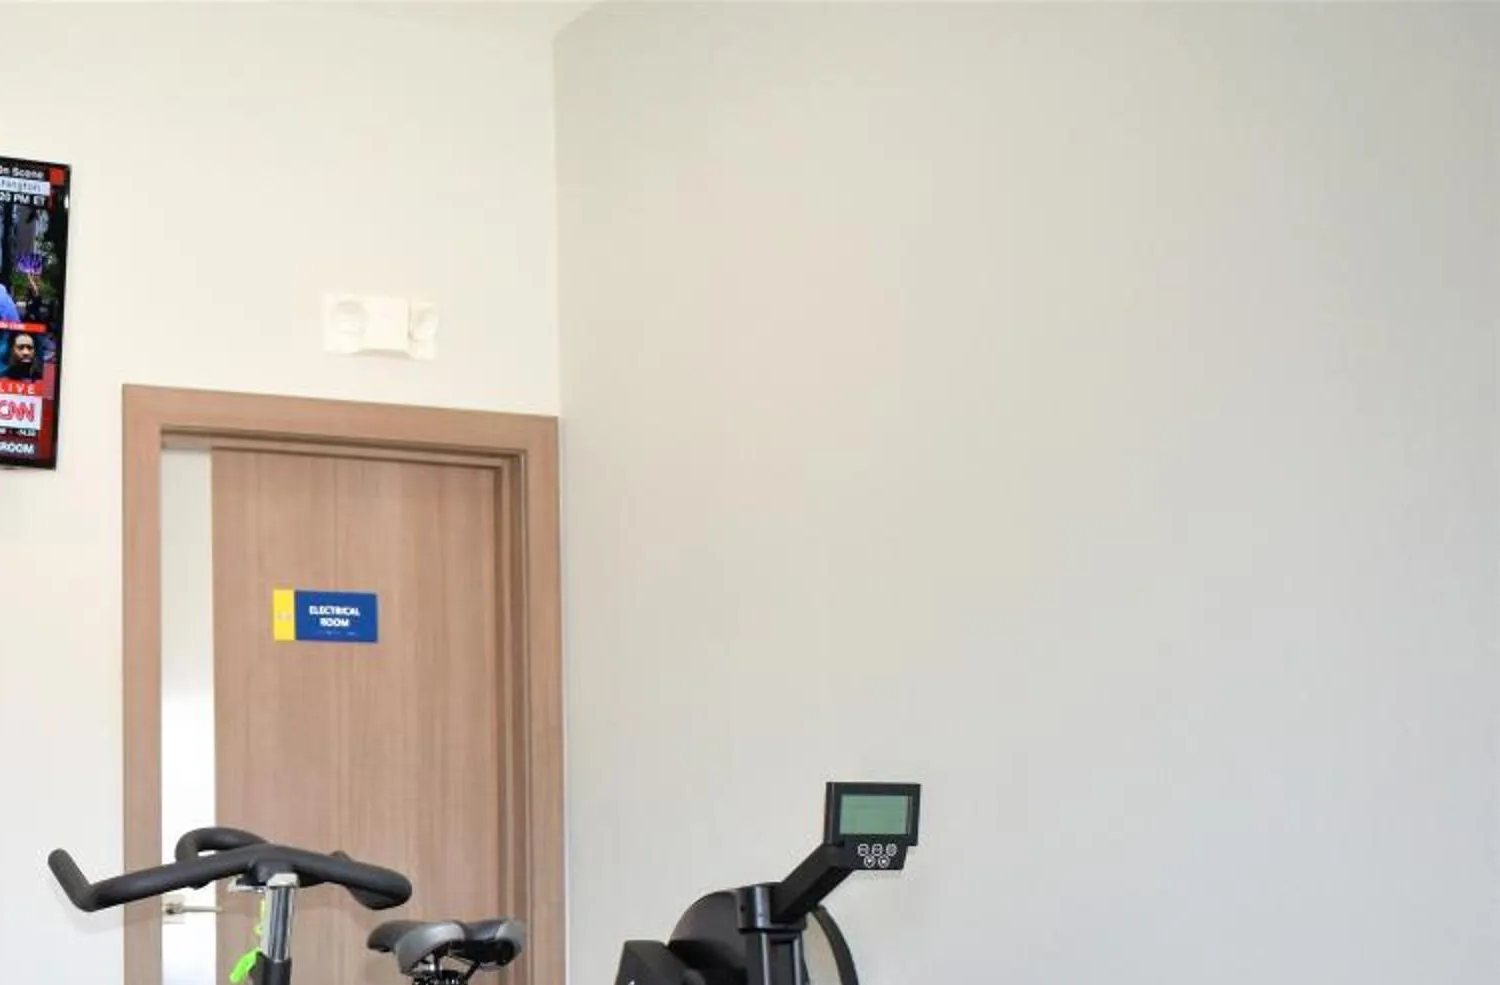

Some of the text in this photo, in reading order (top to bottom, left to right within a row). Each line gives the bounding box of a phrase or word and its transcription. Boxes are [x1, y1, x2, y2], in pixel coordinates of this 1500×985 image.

[12, 167, 44, 179] Scene
[308, 605, 360, 617] ELECTRICAL
[320, 617, 350, 628] ROOM
